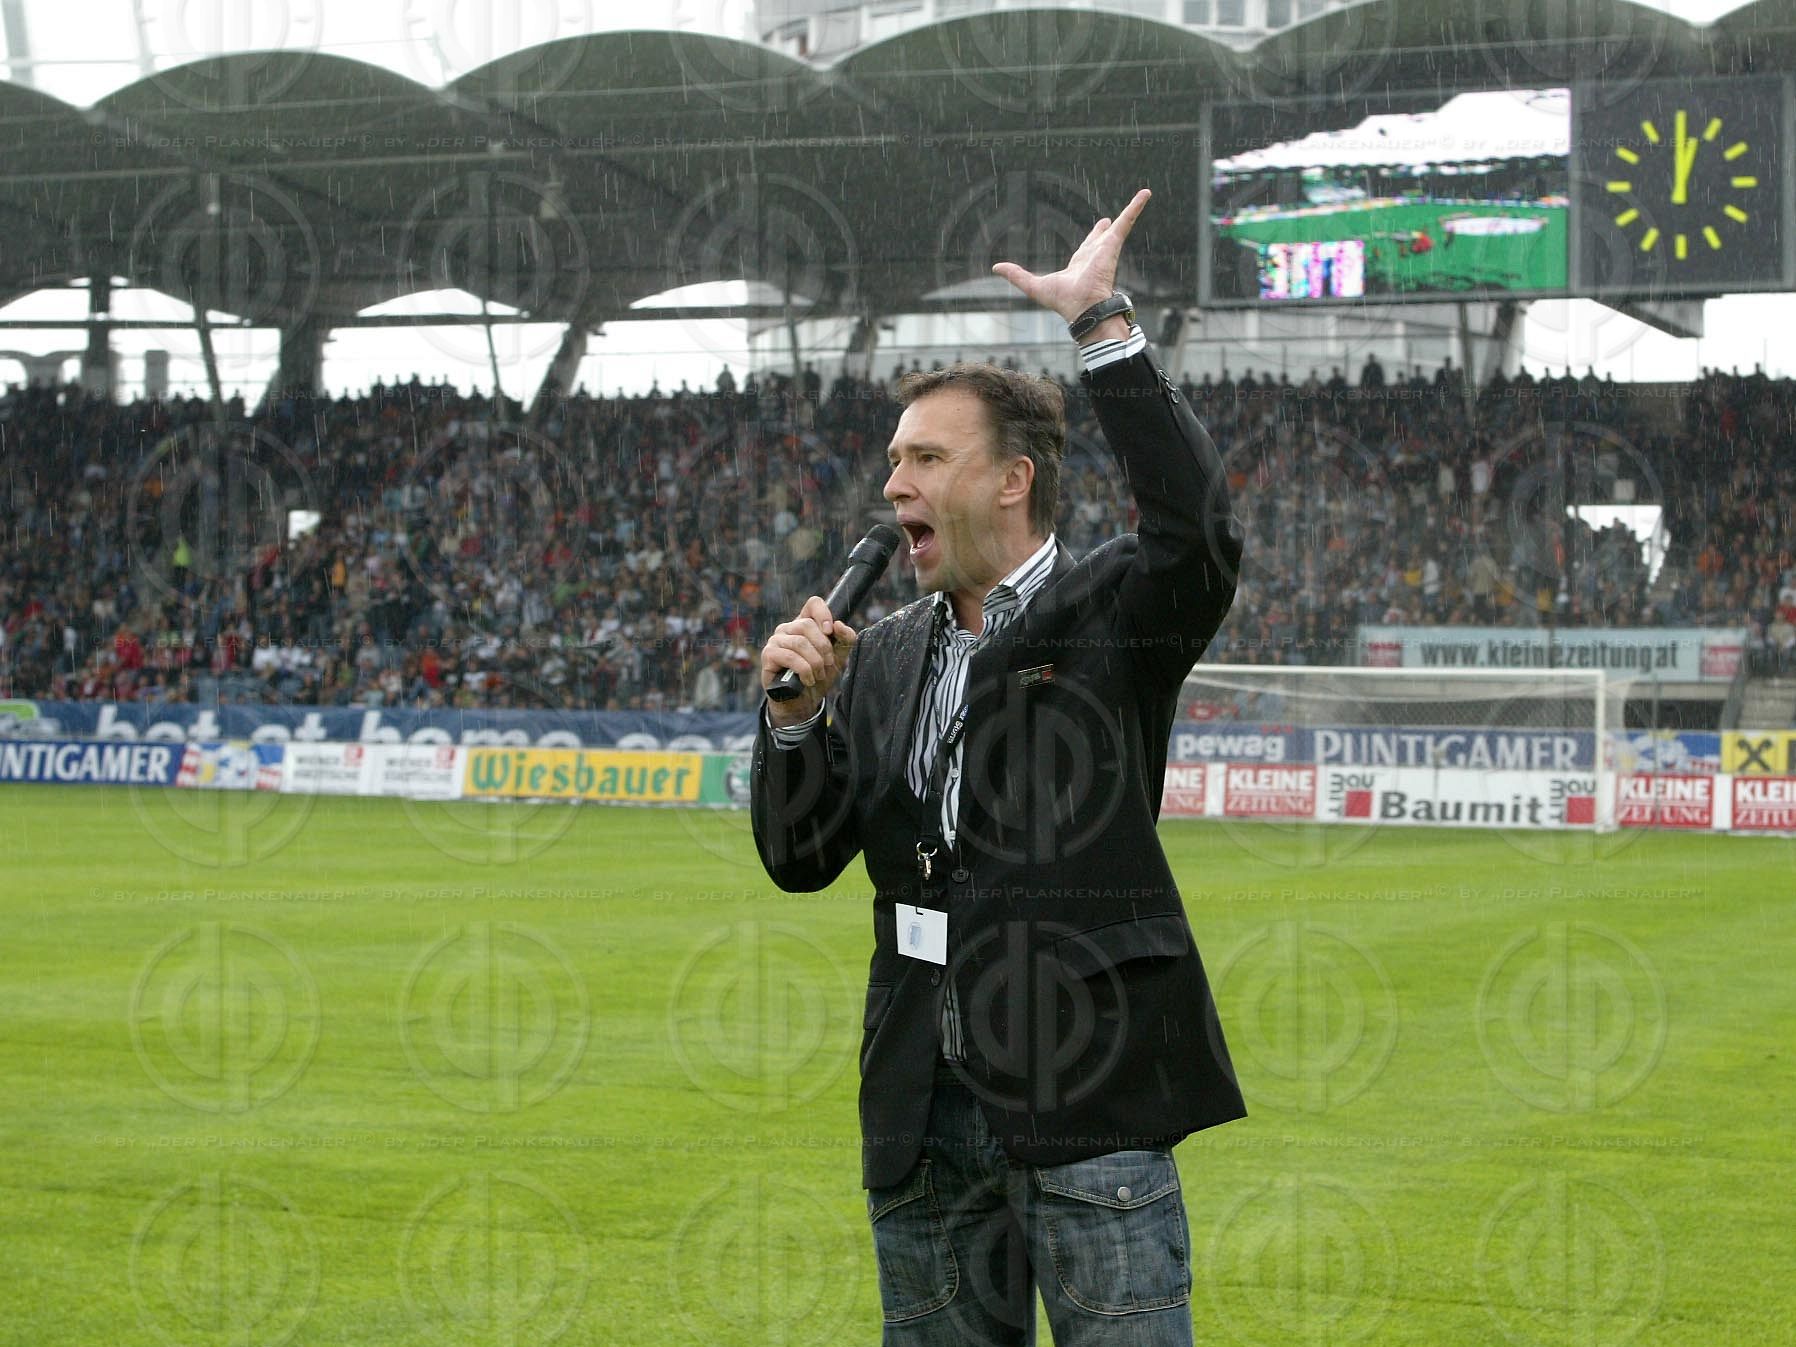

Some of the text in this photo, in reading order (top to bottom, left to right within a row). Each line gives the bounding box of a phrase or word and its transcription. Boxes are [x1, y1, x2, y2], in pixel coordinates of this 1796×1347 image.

[1176, 733, 1285, 762] pewag
[1314, 729, 1578, 770] PUNTIGAMER
[0, 743, 171, 783] NTIGAMER
[472, 751, 690, 796] Wiesbauer
[1229, 765, 1315, 790] KLEINE
[1227, 794, 1313, 812] ZEITUNG
[1620, 777, 1710, 801] KLEINE
[1379, 791, 1543, 823] Baumit
